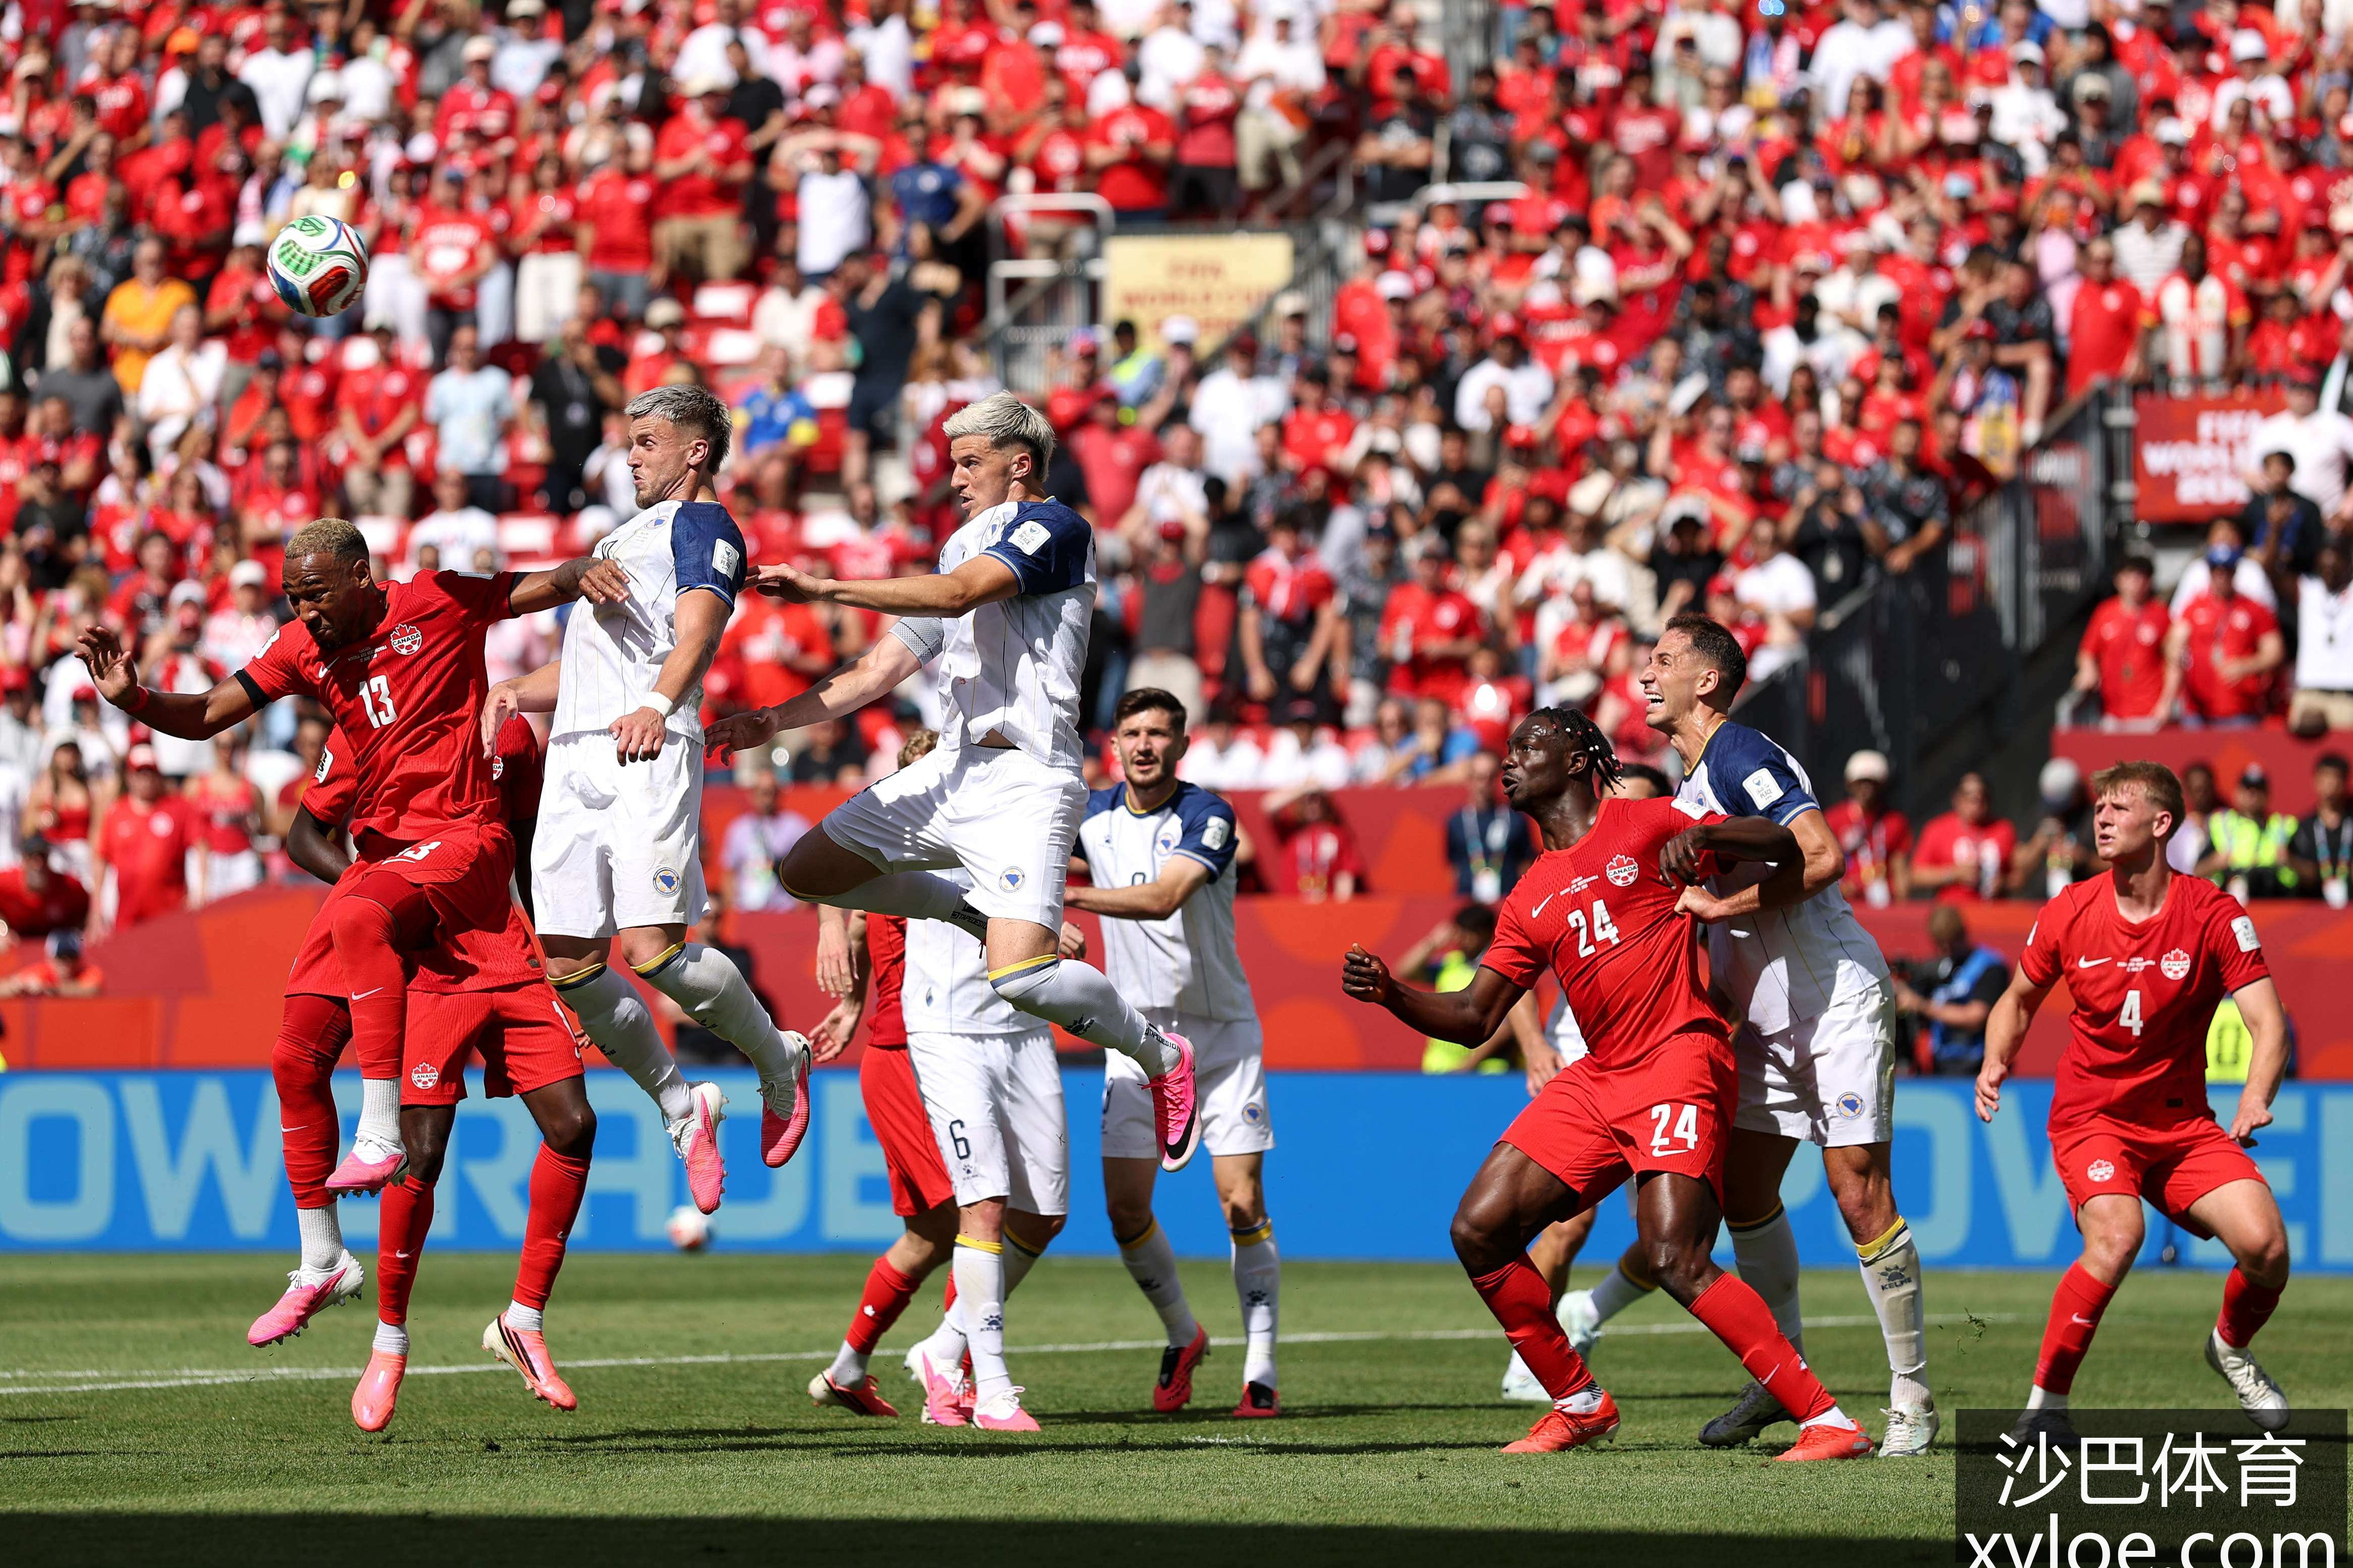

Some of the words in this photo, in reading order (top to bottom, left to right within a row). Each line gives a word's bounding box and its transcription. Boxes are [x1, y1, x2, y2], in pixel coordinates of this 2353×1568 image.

[392, 633, 421, 646] CANADA
[359, 675, 397, 728] 13
[1608, 865, 1638, 877] CANADA
[1567, 899, 1620, 958] 24
[2119, 989, 2143, 1036] 4
[950, 1119, 971, 1160] 6
[1650, 1104, 1698, 1150] 24
